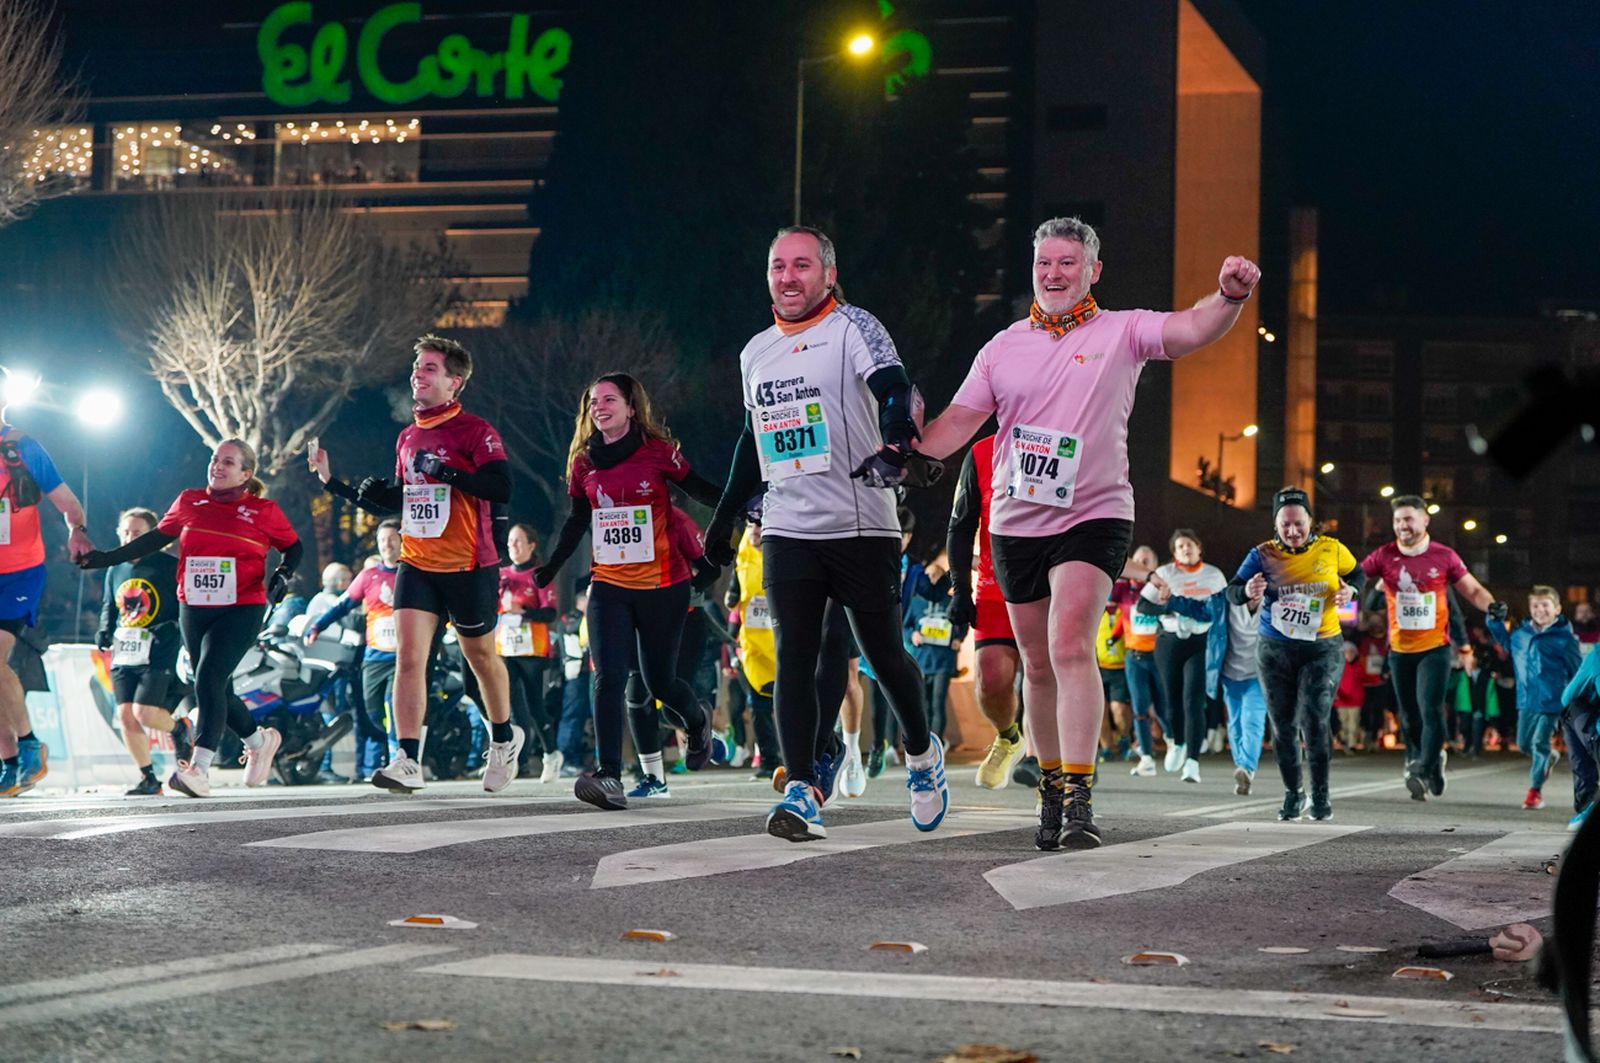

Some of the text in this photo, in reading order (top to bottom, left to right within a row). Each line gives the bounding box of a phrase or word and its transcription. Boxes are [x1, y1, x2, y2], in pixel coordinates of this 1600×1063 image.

[258, 2, 572, 107] El Corte
[756, 376, 804, 407] 43 Carrera
[777, 386, 821, 404] San Antón
[771, 412, 791, 421] NOCHE
[792, 409, 800, 418] DE
[763, 422, 778, 432] SAN
[774, 426, 816, 453] 8371
[1022, 433, 1042, 444] NOCHE
[1042, 437, 1052, 445] DE
[410, 503, 439, 519] 5261
[603, 527, 642, 545] 4389
[194, 574, 225, 589] 6457
[1281, 607, 1311, 625] 2715
